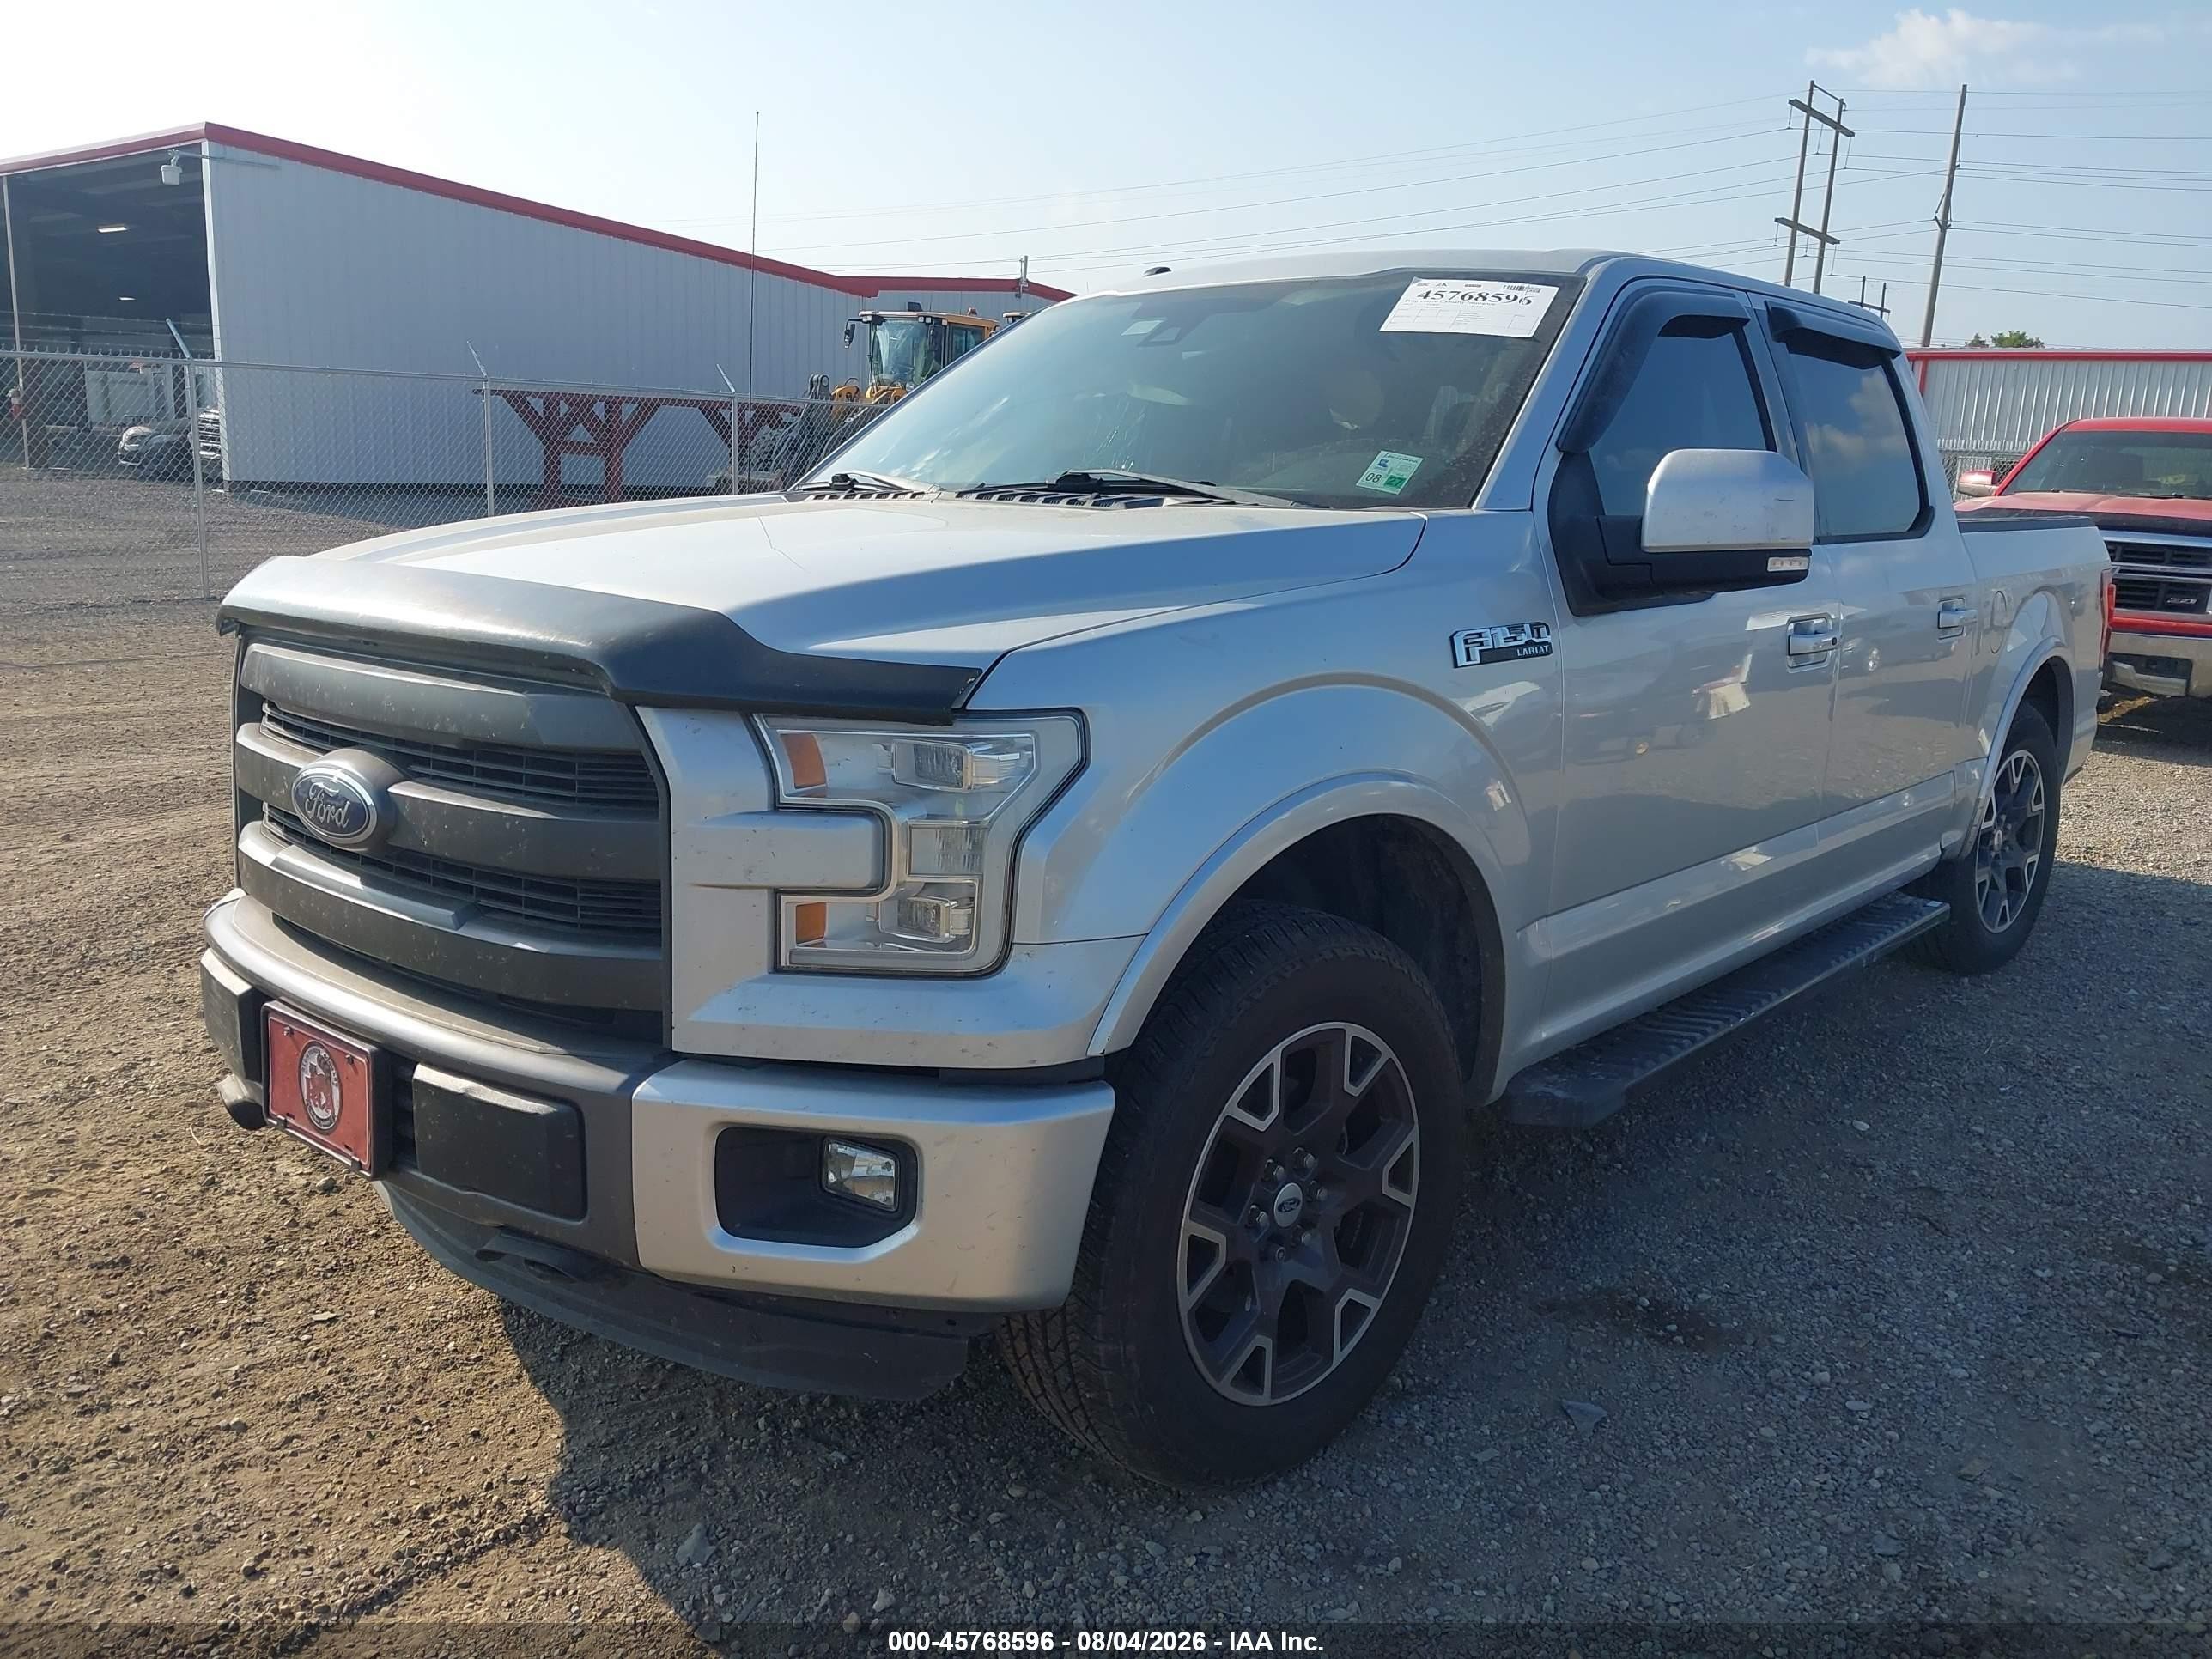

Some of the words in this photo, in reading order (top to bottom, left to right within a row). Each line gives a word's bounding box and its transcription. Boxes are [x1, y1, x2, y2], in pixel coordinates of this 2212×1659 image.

[1416, 289, 1534, 306] 45768596
[1365, 472, 1382, 483] 08
[1516, 644, 1549, 656] LARIAT
[305, 781, 350, 829] Ford
